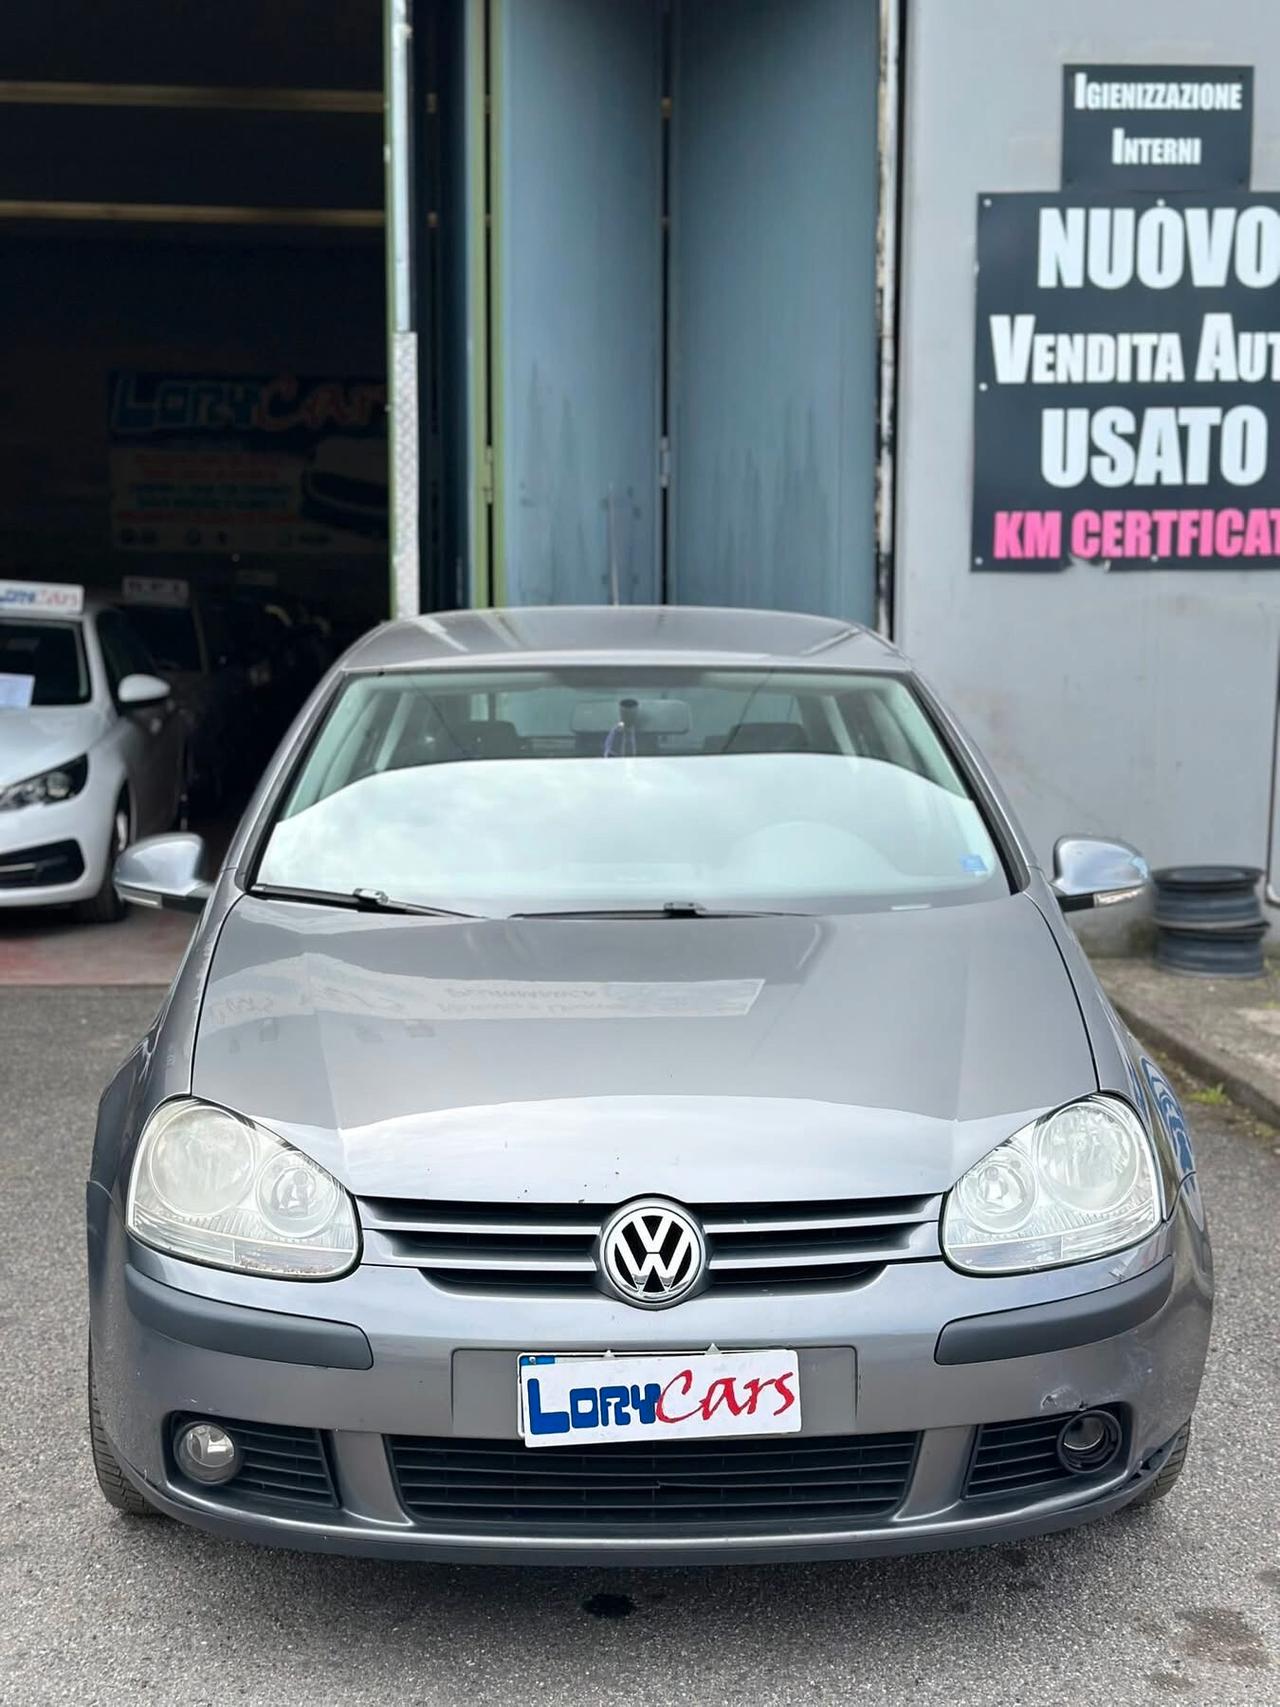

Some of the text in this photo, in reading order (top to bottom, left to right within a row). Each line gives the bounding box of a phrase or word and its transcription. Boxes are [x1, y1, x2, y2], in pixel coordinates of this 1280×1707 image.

[1074, 72, 1242, 110] IGIENIZZAZIONE
[1112, 127, 1202, 164] INTERNI
[1037, 206, 1280, 290] NUOVO
[989, 314, 1185, 384] VENDITA
[1041, 405, 1268, 488] USATO
[993, 511, 1062, 559] KM
